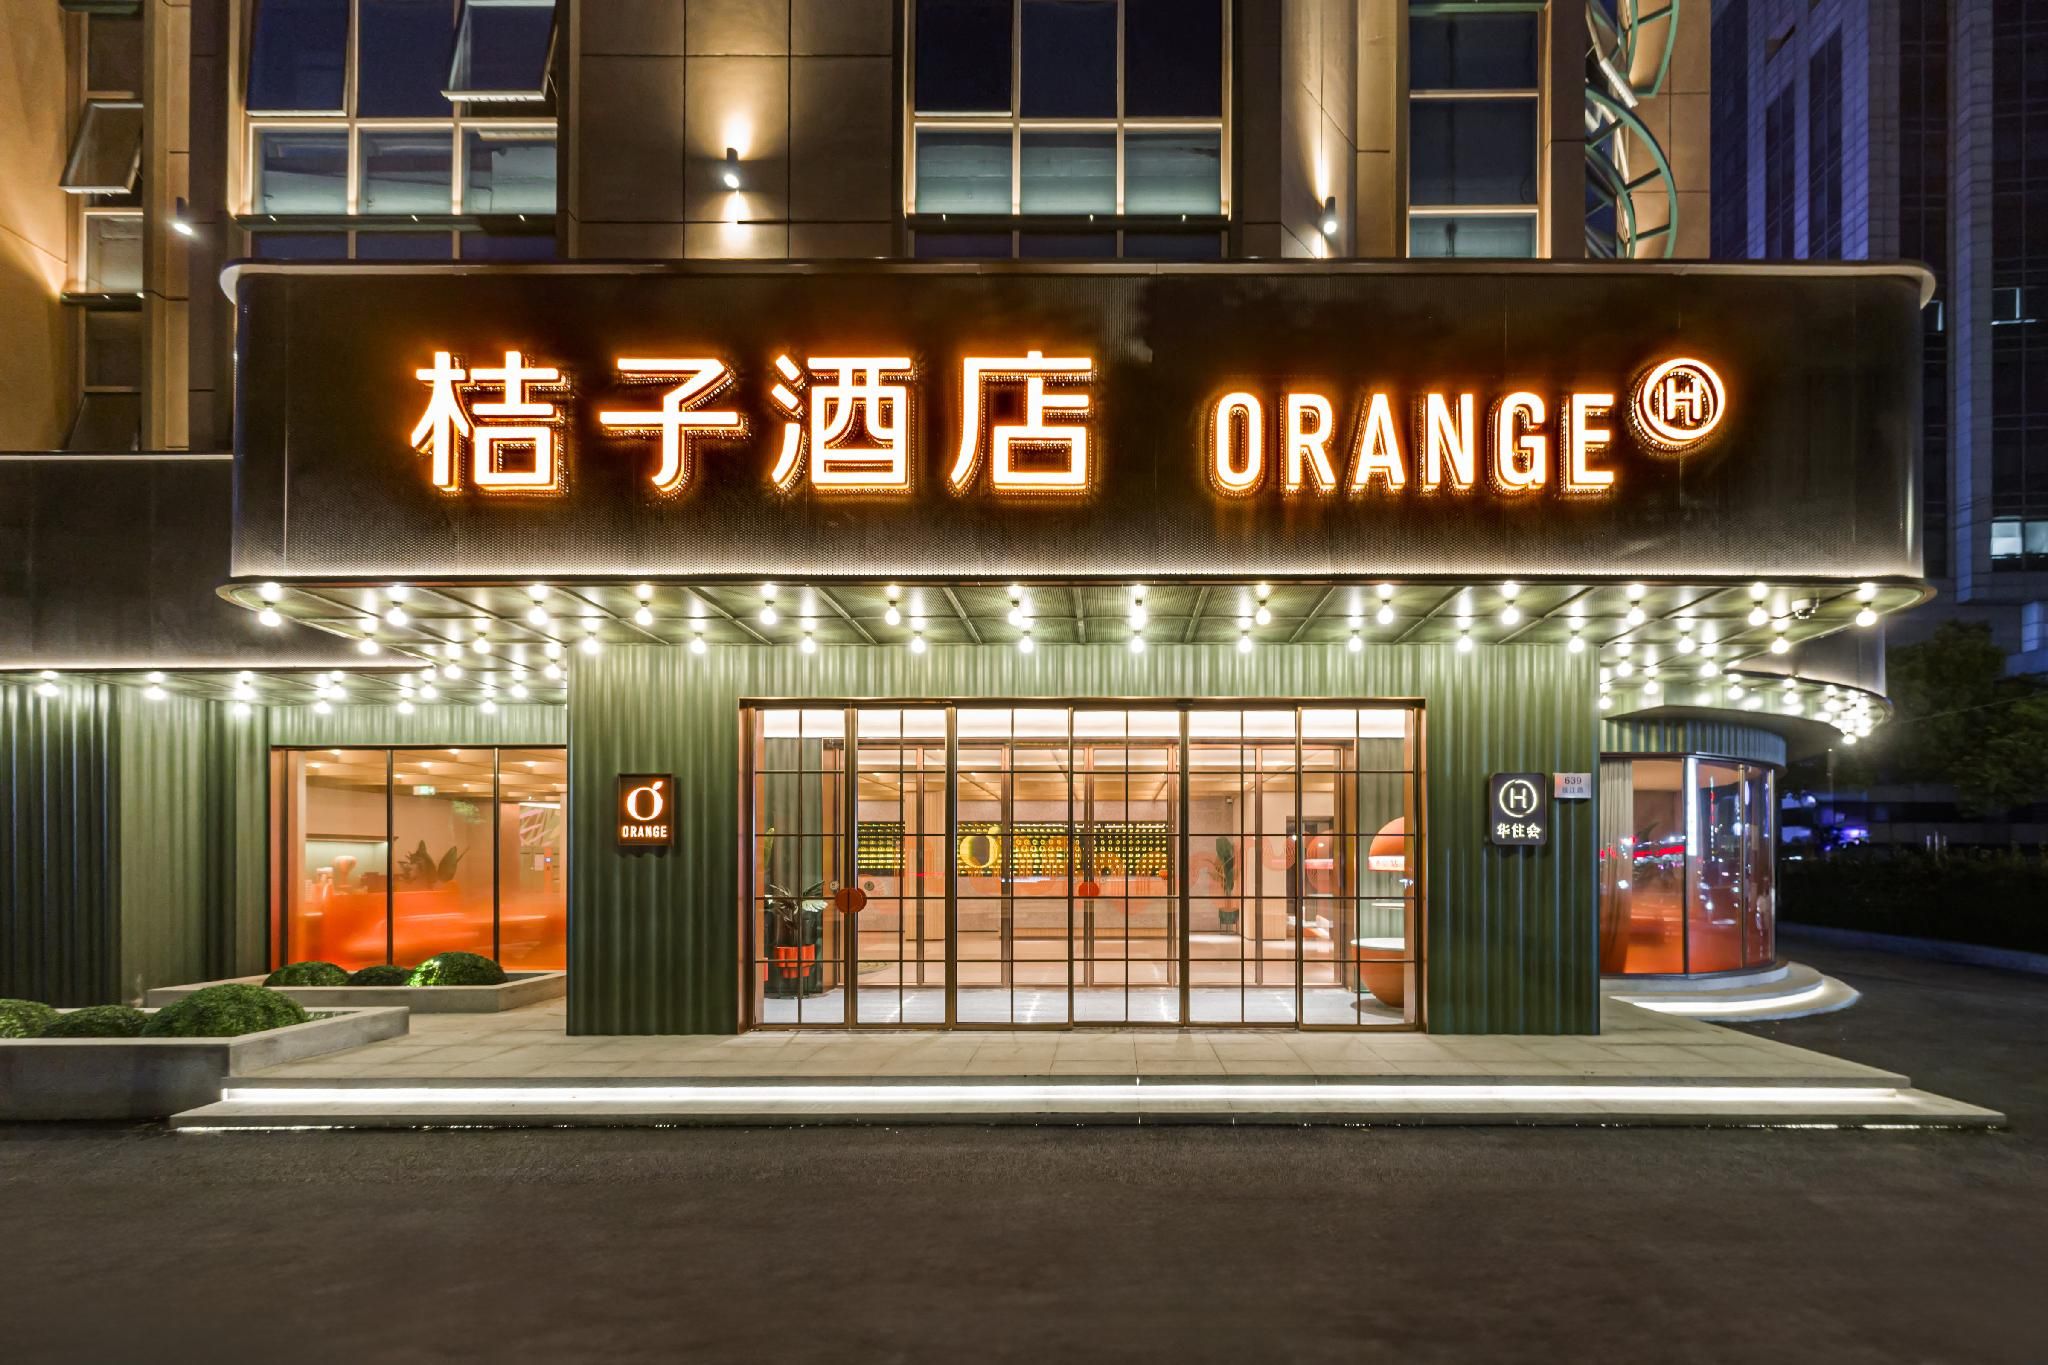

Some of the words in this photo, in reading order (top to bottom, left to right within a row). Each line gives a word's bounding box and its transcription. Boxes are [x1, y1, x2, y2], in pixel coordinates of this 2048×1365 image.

[411, 351, 1094, 491] 桔子酒店
[1212, 391, 1616, 492] ORANGE
[622, 825, 668, 838] ORANGE
[1496, 822, 1541, 839] 华住会
